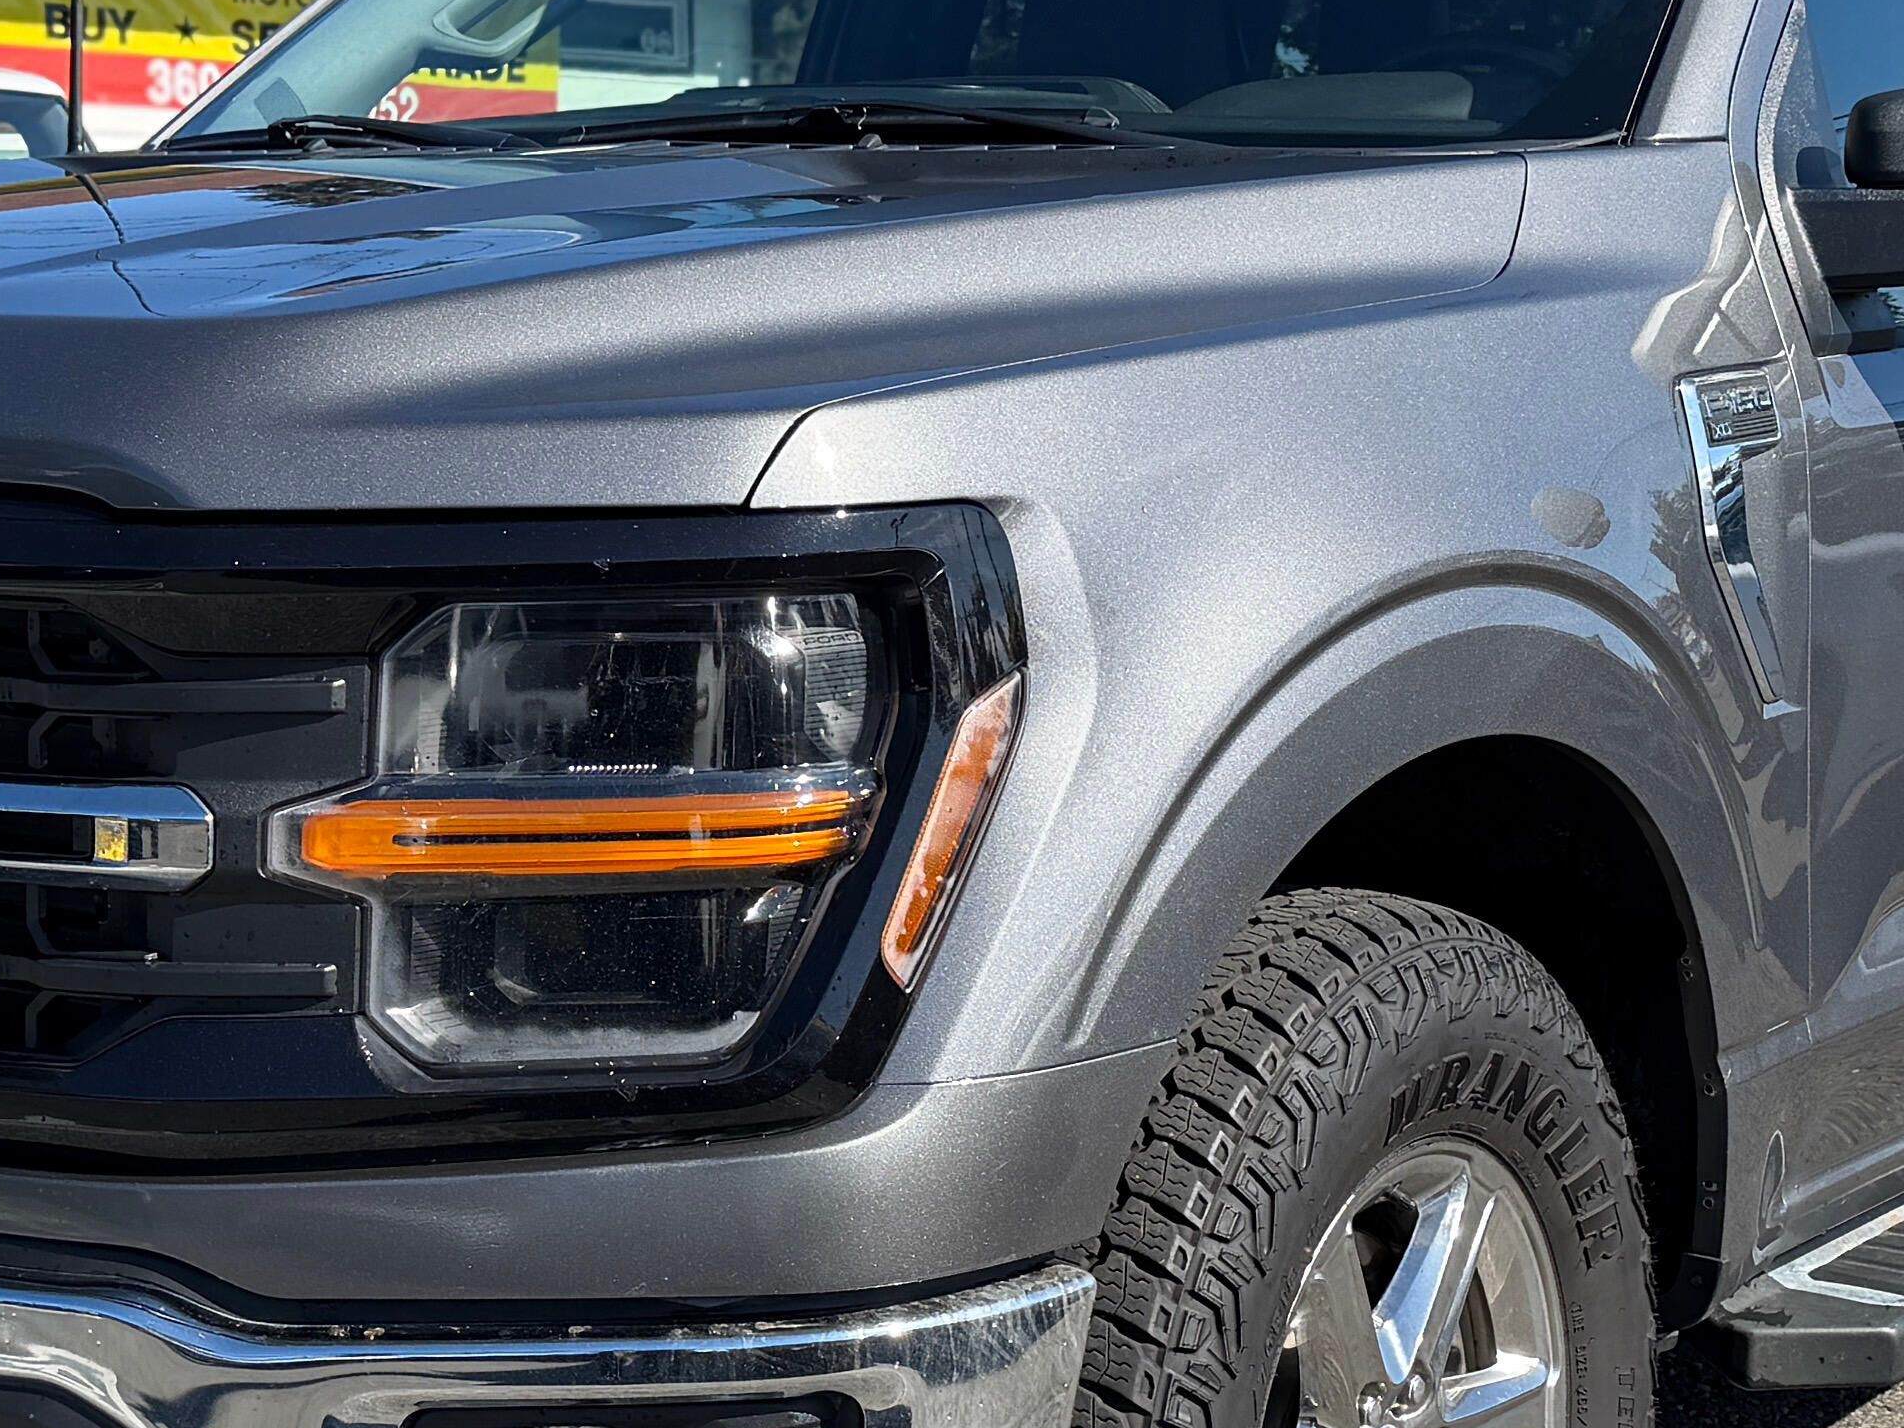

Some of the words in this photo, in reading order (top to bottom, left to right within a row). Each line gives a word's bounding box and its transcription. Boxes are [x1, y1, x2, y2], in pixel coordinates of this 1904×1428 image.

[44, 2, 137, 45] BUY
[369, 86, 419, 123] 52
[1383, 1050, 1624, 1270] WRANGLER
[1572, 1302, 1585, 1334] TIRE
